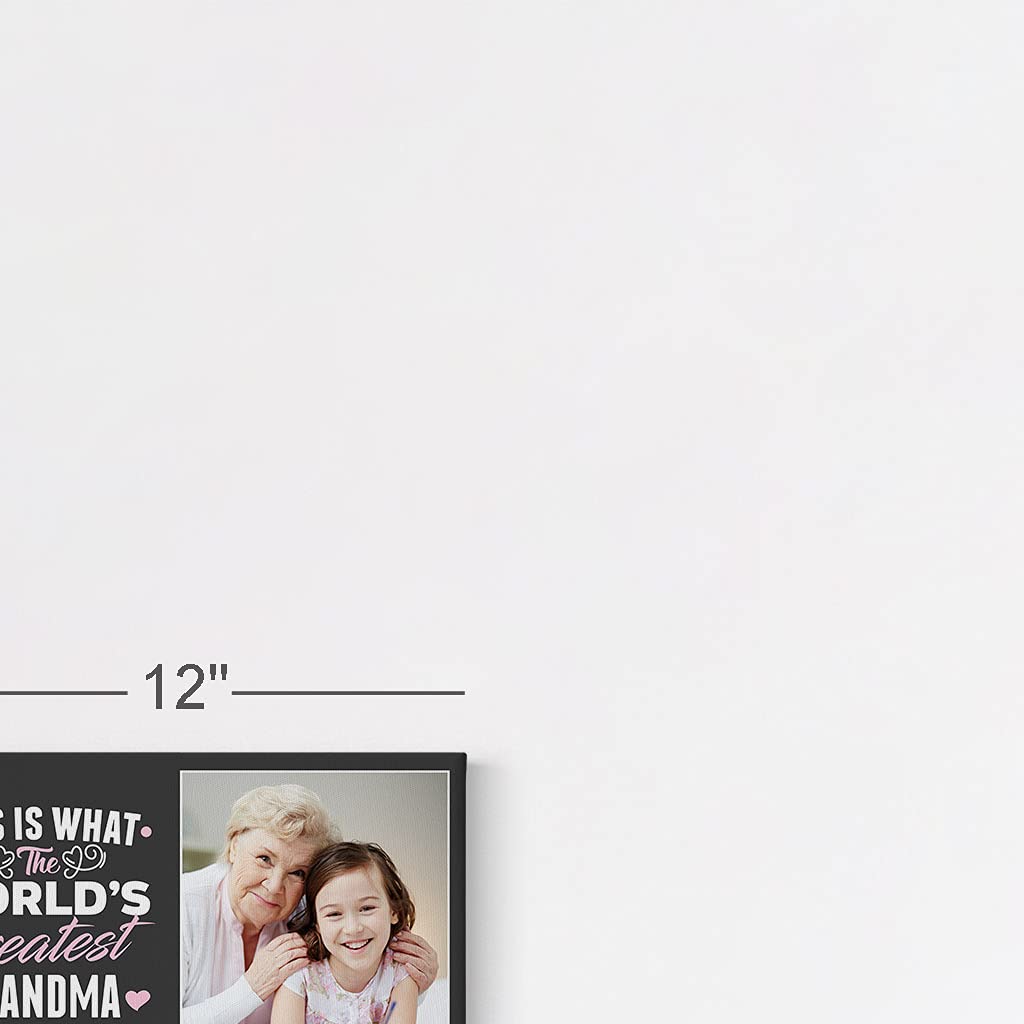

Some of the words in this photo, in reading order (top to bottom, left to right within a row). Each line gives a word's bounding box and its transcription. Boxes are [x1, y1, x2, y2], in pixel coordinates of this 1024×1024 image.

[14, 806, 43, 841] IS
[51, 806, 142, 847] WHAT
[16, 846, 61, 876] The
